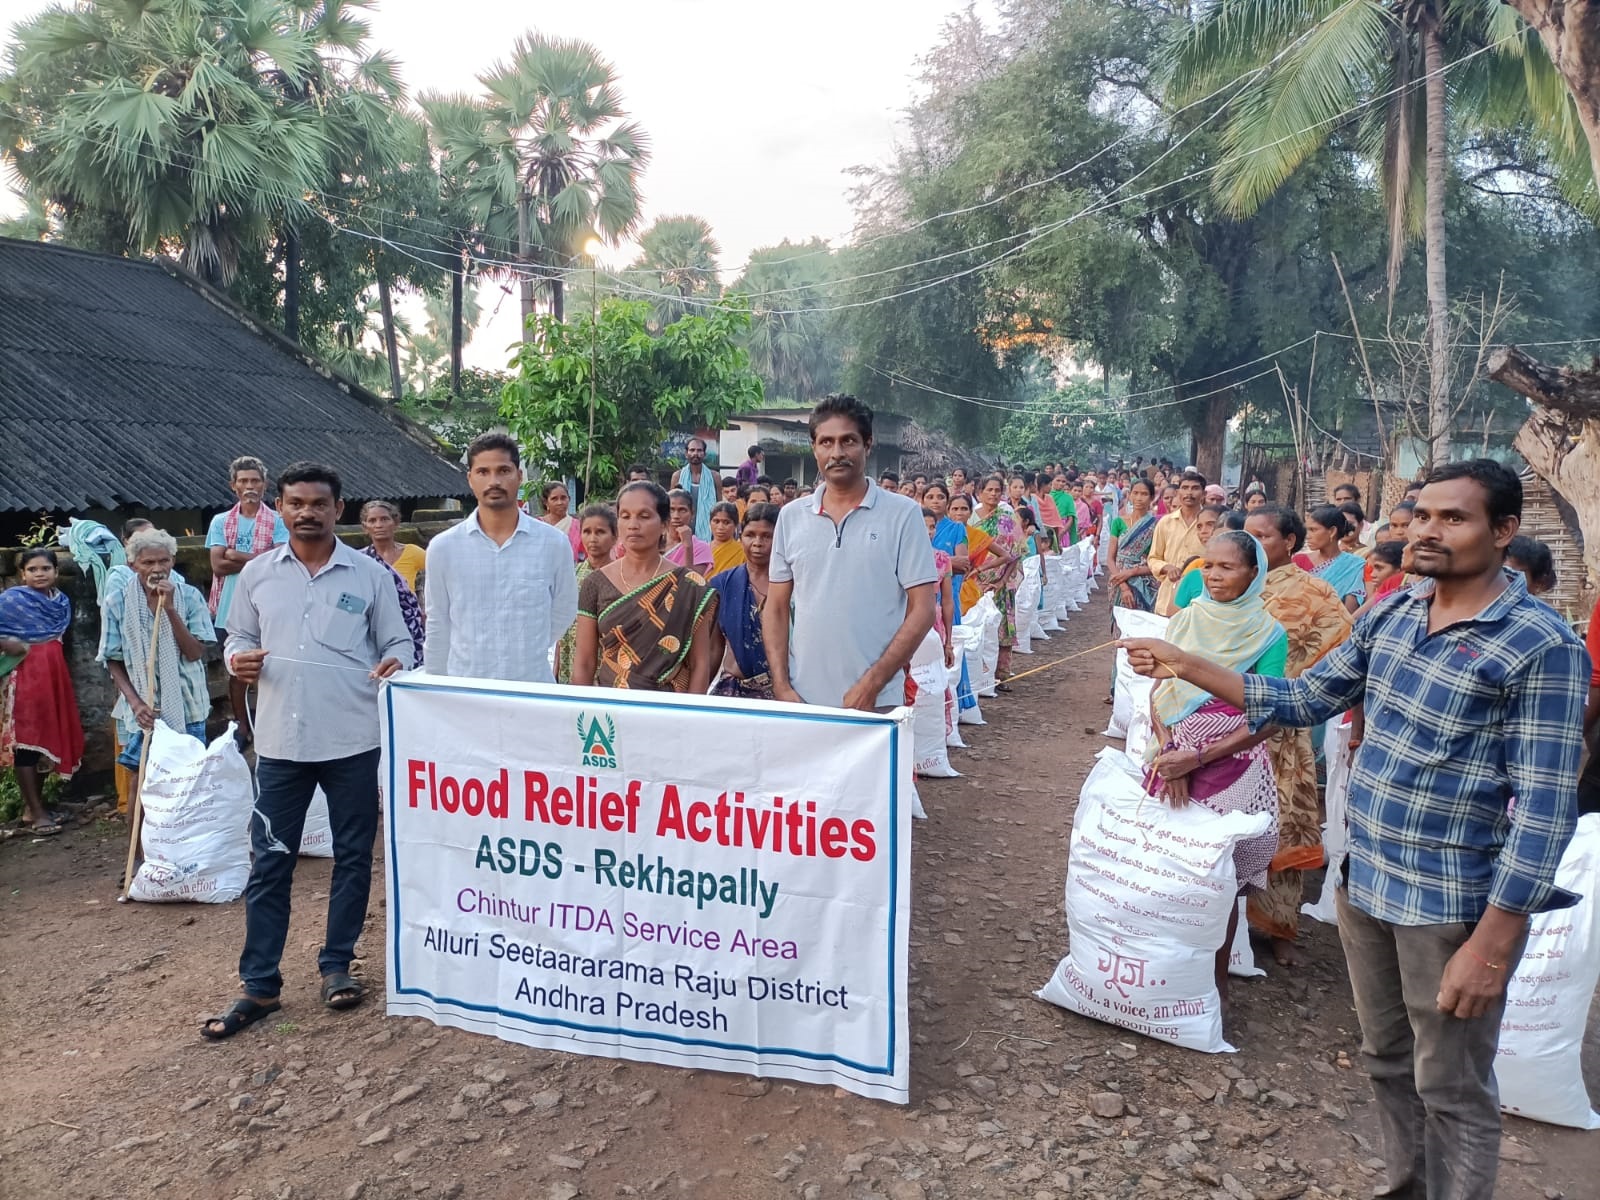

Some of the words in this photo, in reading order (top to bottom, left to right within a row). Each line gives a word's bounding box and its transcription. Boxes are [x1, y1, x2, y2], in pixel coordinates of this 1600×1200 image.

[583, 755, 616, 768] ASDS
[303, 832, 326, 846] effort
[407, 760, 509, 819] Flood
[524, 769, 641, 834] Relief
[656, 784, 877, 862] Activities
[191, 879, 217, 893] effort
[475, 835, 563, 880] ASDS
[594, 848, 779, 919] Rekhapally
[456, 887, 541, 926] Chintur
[549, 902, 614, 936] ITDA
[623, 911, 721, 951] Service
[729, 929, 798, 961] Area
[423, 926, 479, 958] Alluri
[488, 933, 665, 986] Seetaararama
[674, 965, 737, 1001] Raju
[748, 976, 848, 1011] District
[515, 977, 606, 1015] Andhra
[617, 992, 729, 1033] Pradesh
[1103, 998, 1110, 1009] a
[1113, 1001, 1150, 1020] voice,
[1154, 1005, 1169, 1018] an
[1172, 999, 1206, 1017] effort
